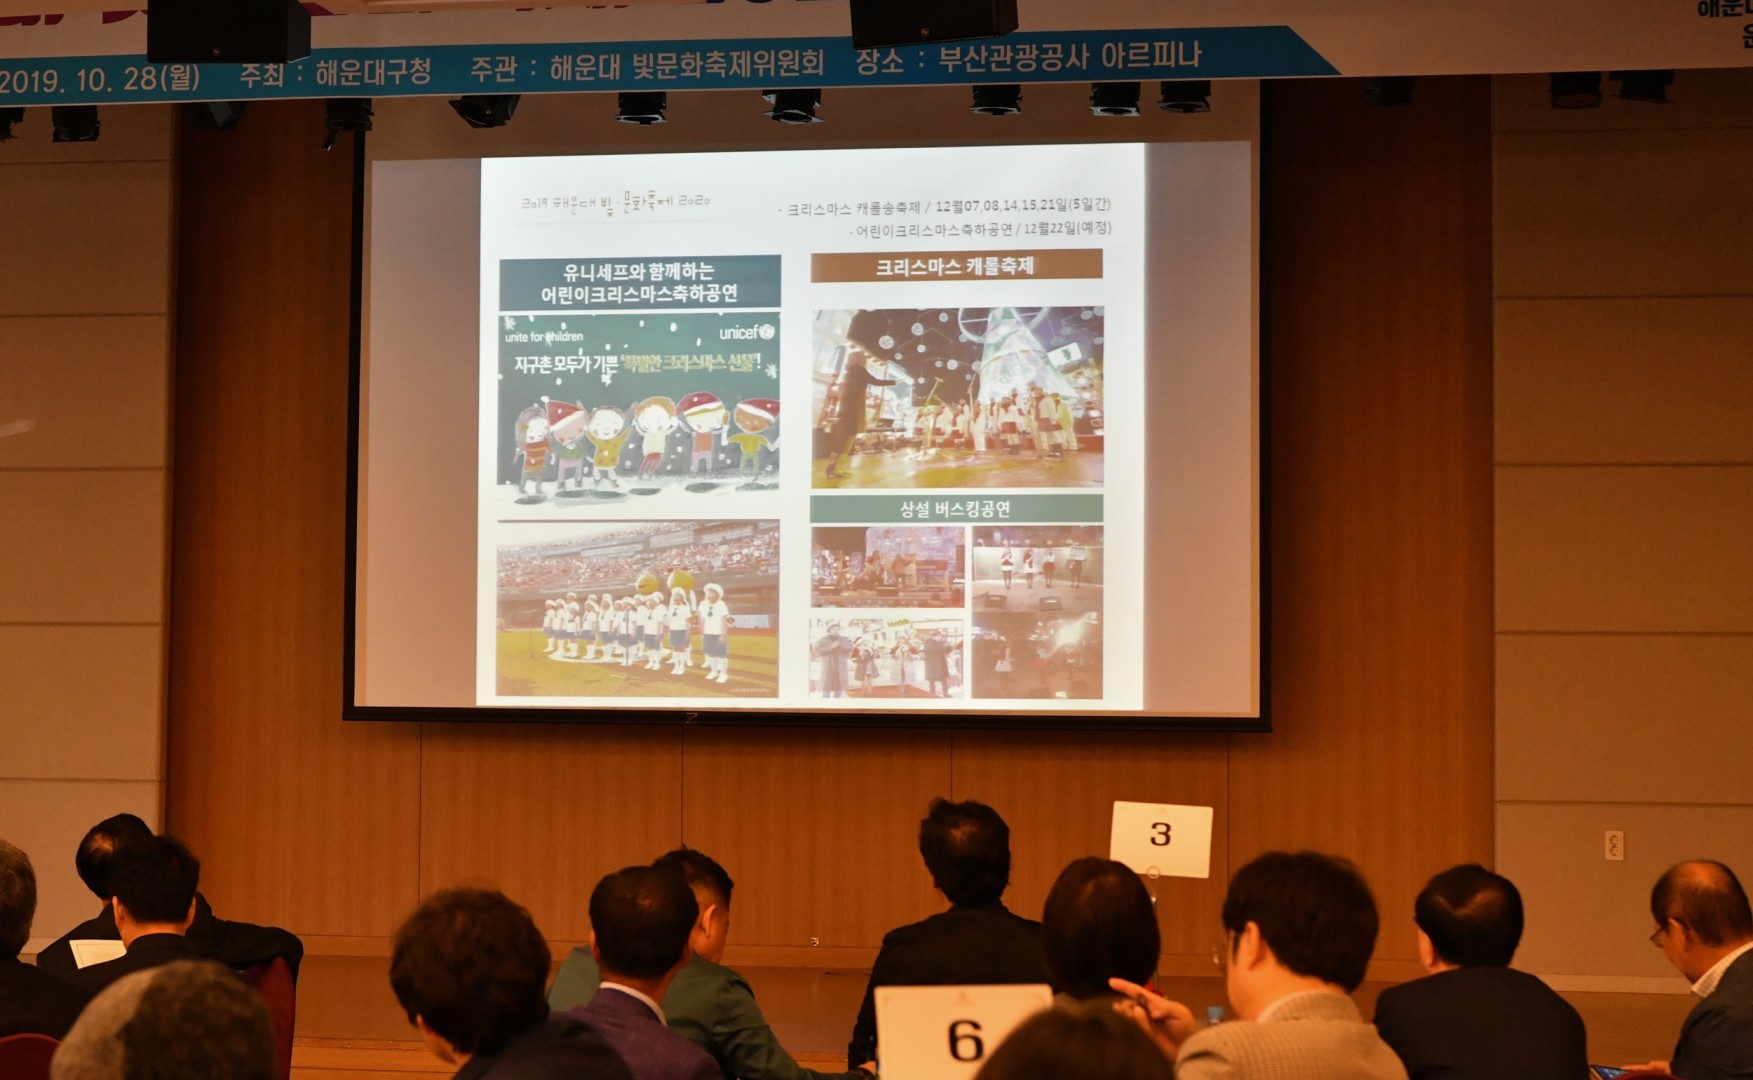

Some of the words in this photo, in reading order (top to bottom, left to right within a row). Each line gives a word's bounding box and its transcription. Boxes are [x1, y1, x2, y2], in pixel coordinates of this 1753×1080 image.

[0, 69, 65, 94] 2019.
[77, 67, 112, 92] 10.
[124, 63, 200, 92] 28(월)
[240, 63, 285, 89] 주최
[316, 57, 431, 87] 해운대구청
[471, 55, 517, 83] 주관
[550, 53, 621, 82] 해운대
[633, 49, 824, 80] 빛문화축제위원회
[856, 48, 905, 76] 장소
[939, 43, 1090, 74] 부산관광공사
[1101, 39, 1203, 69] 아르피나
[522, 197, 548, 209] 2019
[788, 203, 852, 217] 크리스마스
[856, 200, 920, 216] 캐롤송축제
[563, 262, 646, 283] 유니세프와
[649, 261, 715, 282] 함께하는
[876, 257, 962, 277] 크리스마스
[966, 255, 1034, 276] 캐롤축제
[541, 283, 738, 305] 어린이크리스마스축하공연
[505, 332, 529, 343] unite
[530, 331, 544, 342] for
[546, 330, 584, 342] children
[719, 324, 758, 341] unicef
[515, 355, 552, 374] 지구촌
[553, 354, 592, 374] 모두가
[593, 354, 619, 374] 기쁜
[662, 353, 727, 373] 크리스마스
[900, 501, 930, 518] 상설
[935, 499, 1011, 518] 버스킹공연
[1150, 822, 1172, 846] 3
[947, 1019, 984, 1062] 6
